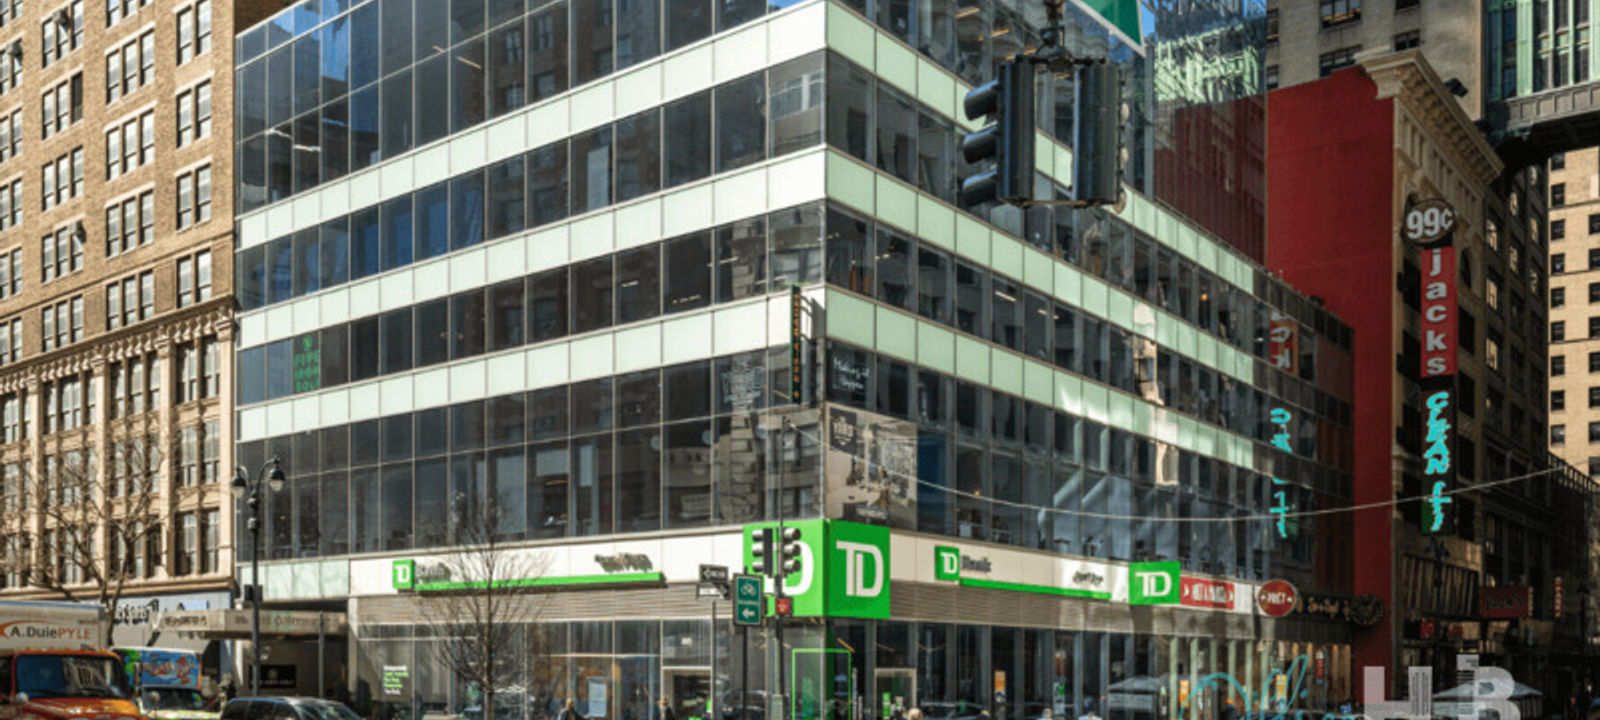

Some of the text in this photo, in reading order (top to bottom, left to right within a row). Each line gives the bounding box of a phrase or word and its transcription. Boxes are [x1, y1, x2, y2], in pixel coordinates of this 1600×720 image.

[1406, 207, 1454, 240] 99¢
[393, 564, 411, 583] TD
[836, 540, 884, 597] TD
[940, 552, 958, 573] TD
[1136, 571, 1171, 597] TD
